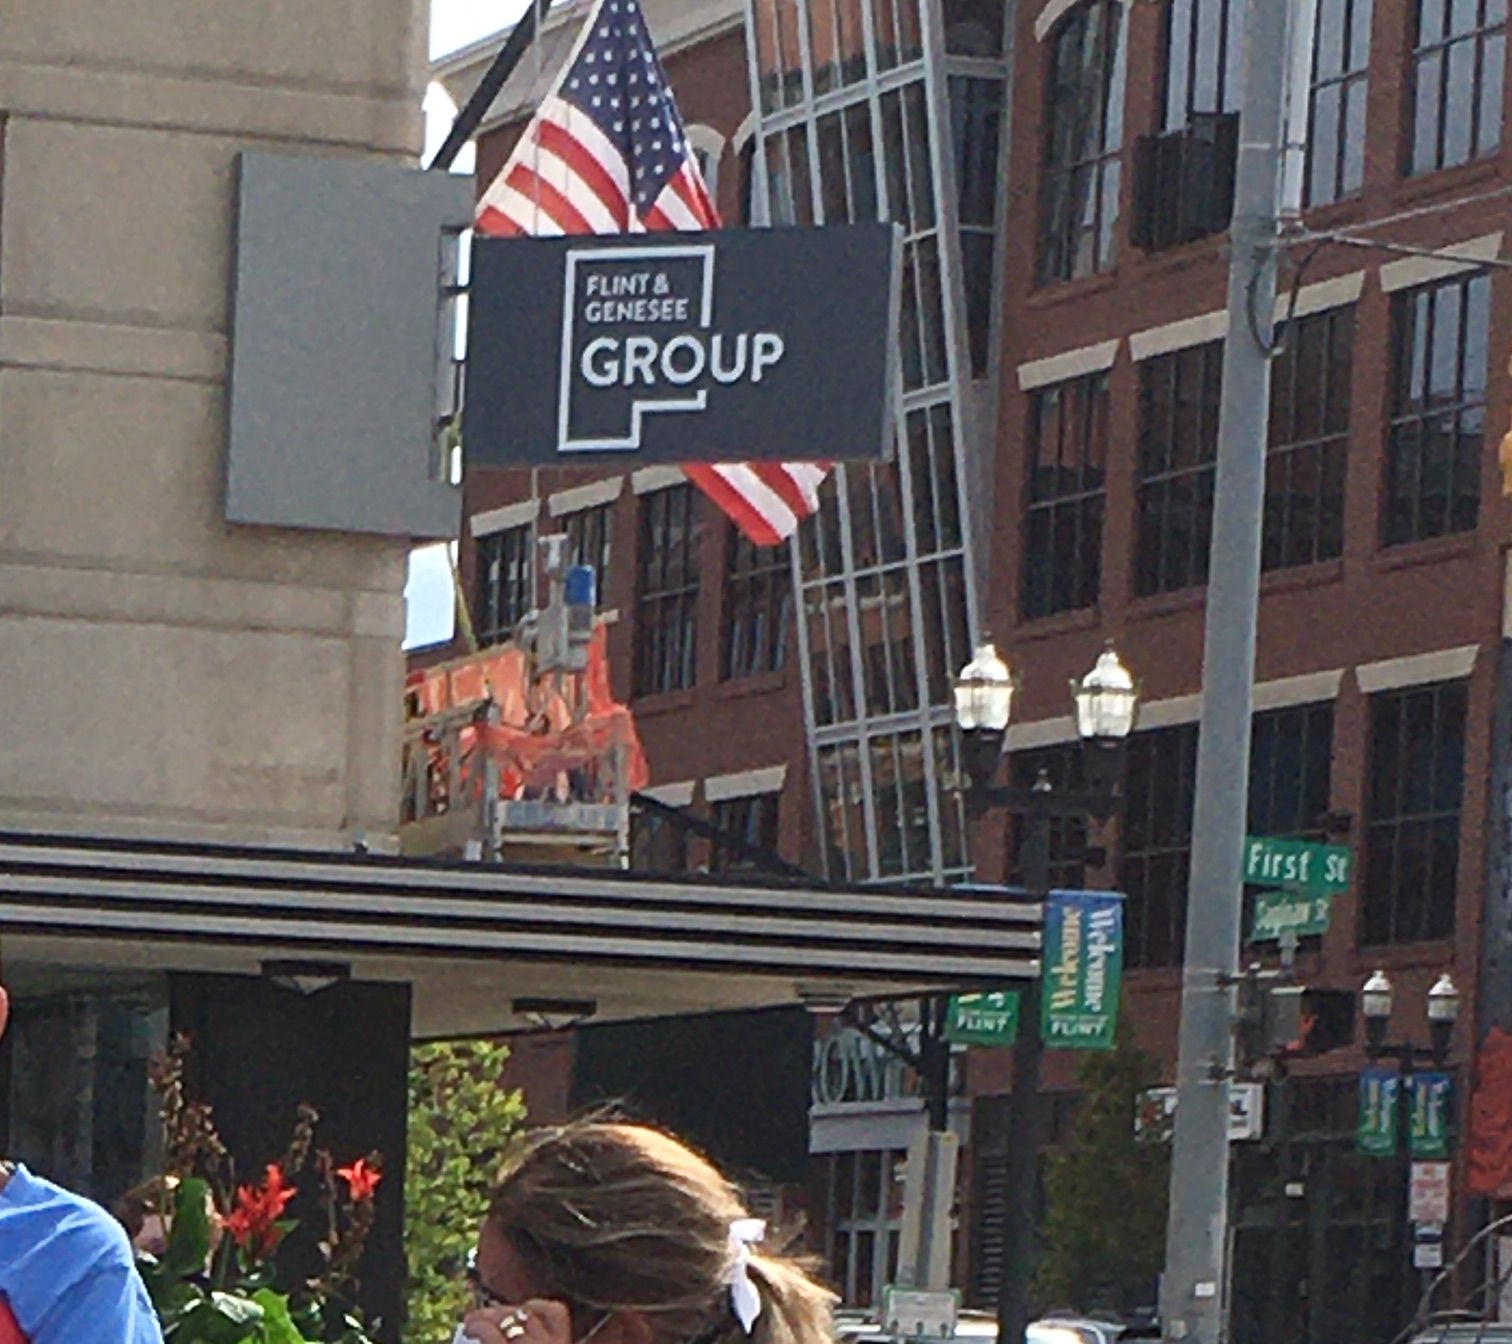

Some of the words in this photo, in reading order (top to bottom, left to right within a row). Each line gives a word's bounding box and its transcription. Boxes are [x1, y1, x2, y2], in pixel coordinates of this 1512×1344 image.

[586, 273, 649, 296] FLINT
[653, 272, 669, 295] &
[585, 298, 689, 322] GENESEE
[581, 333, 785, 387] GROUP
[1248, 843, 1311, 881] First
[1324, 854, 1348, 882] St
[1084, 903, 1117, 1012] Welcome
